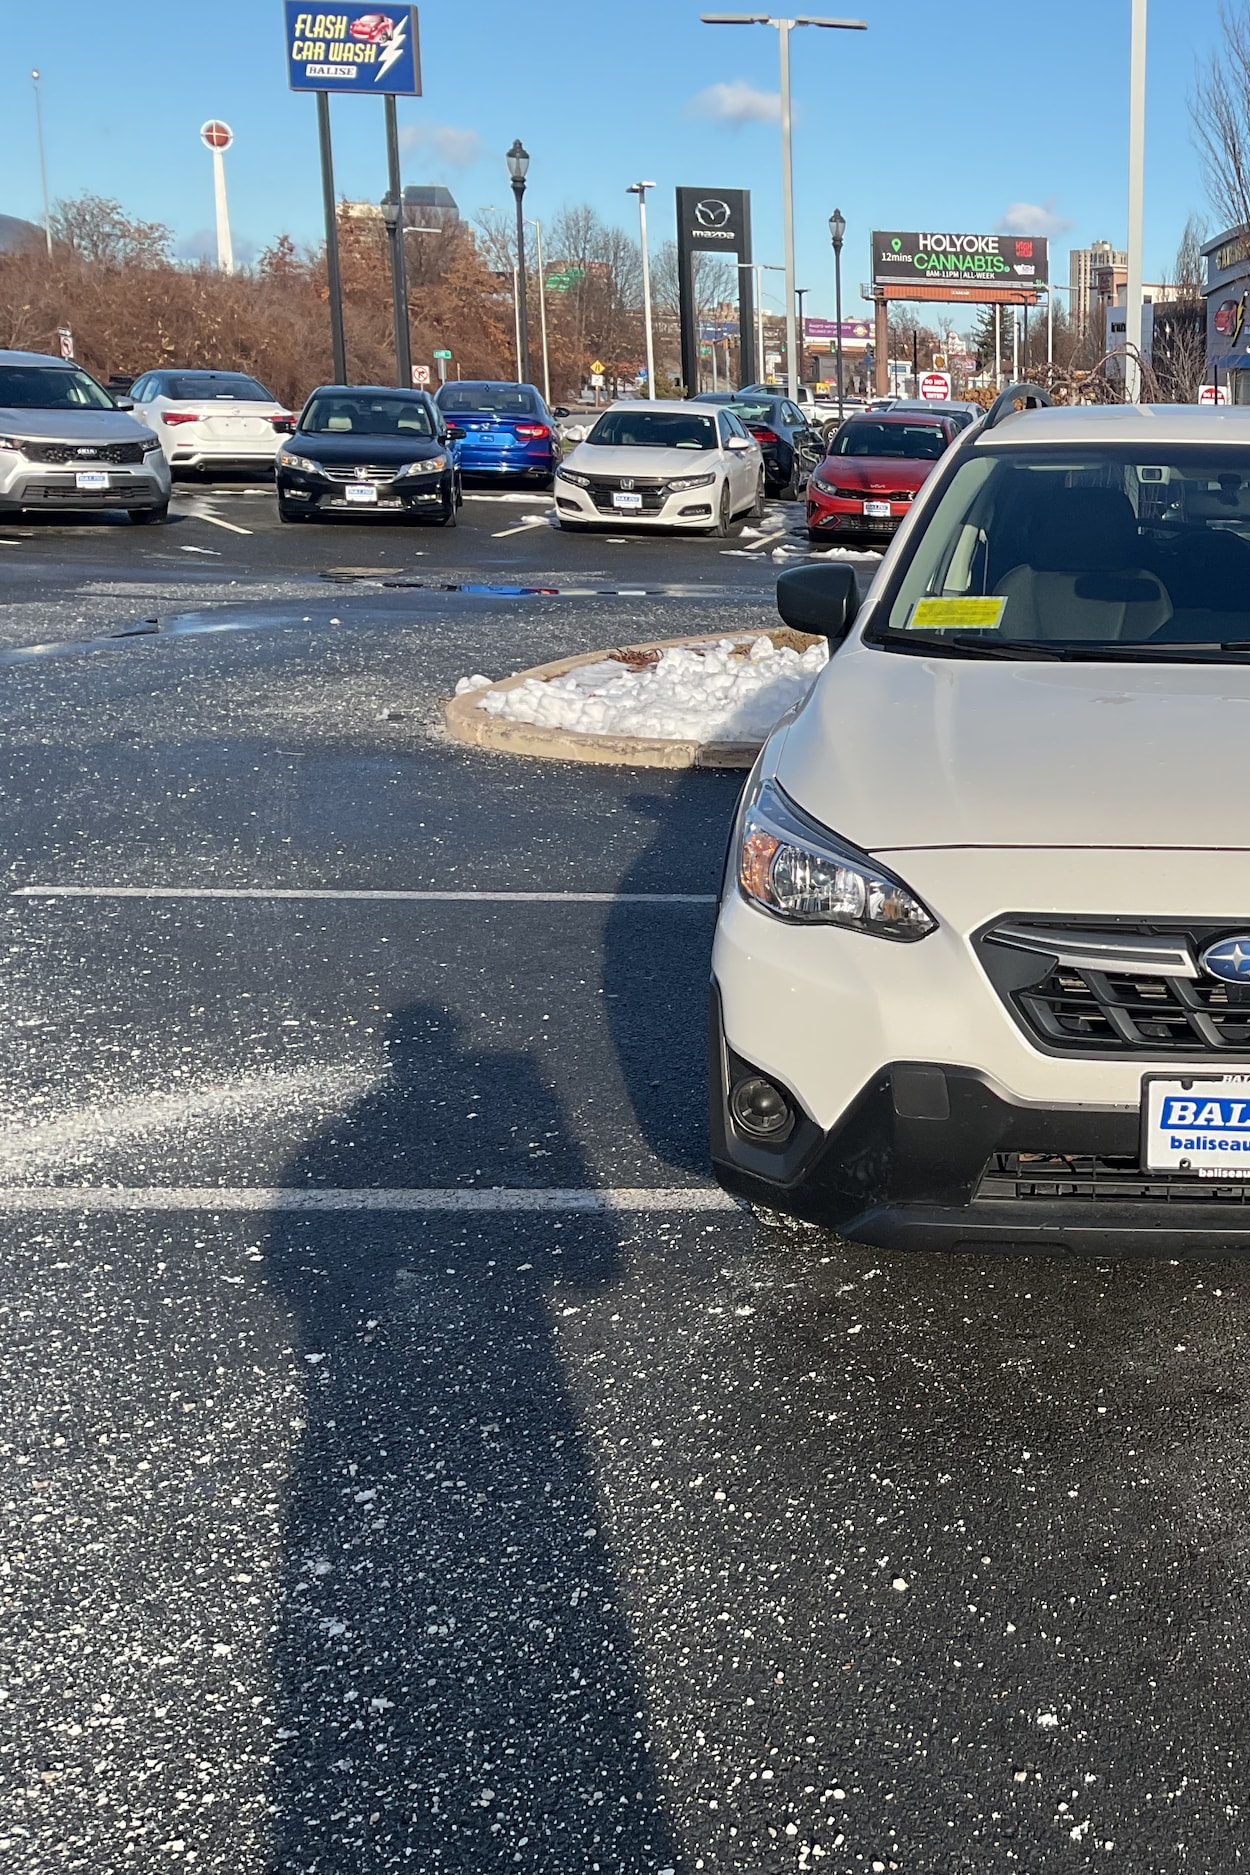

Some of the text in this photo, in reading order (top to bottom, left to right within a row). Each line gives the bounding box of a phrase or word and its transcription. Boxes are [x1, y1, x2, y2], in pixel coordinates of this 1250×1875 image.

[295, 14, 347, 39] FLASH
[292, 40, 376, 62] CAR WASH
[308, 66, 354, 76] BALISE
[918, 233, 999, 254] HOLYOKE
[881, 252, 912, 263] 12mins
[926, 270, 959, 279] 8AM-11PM
